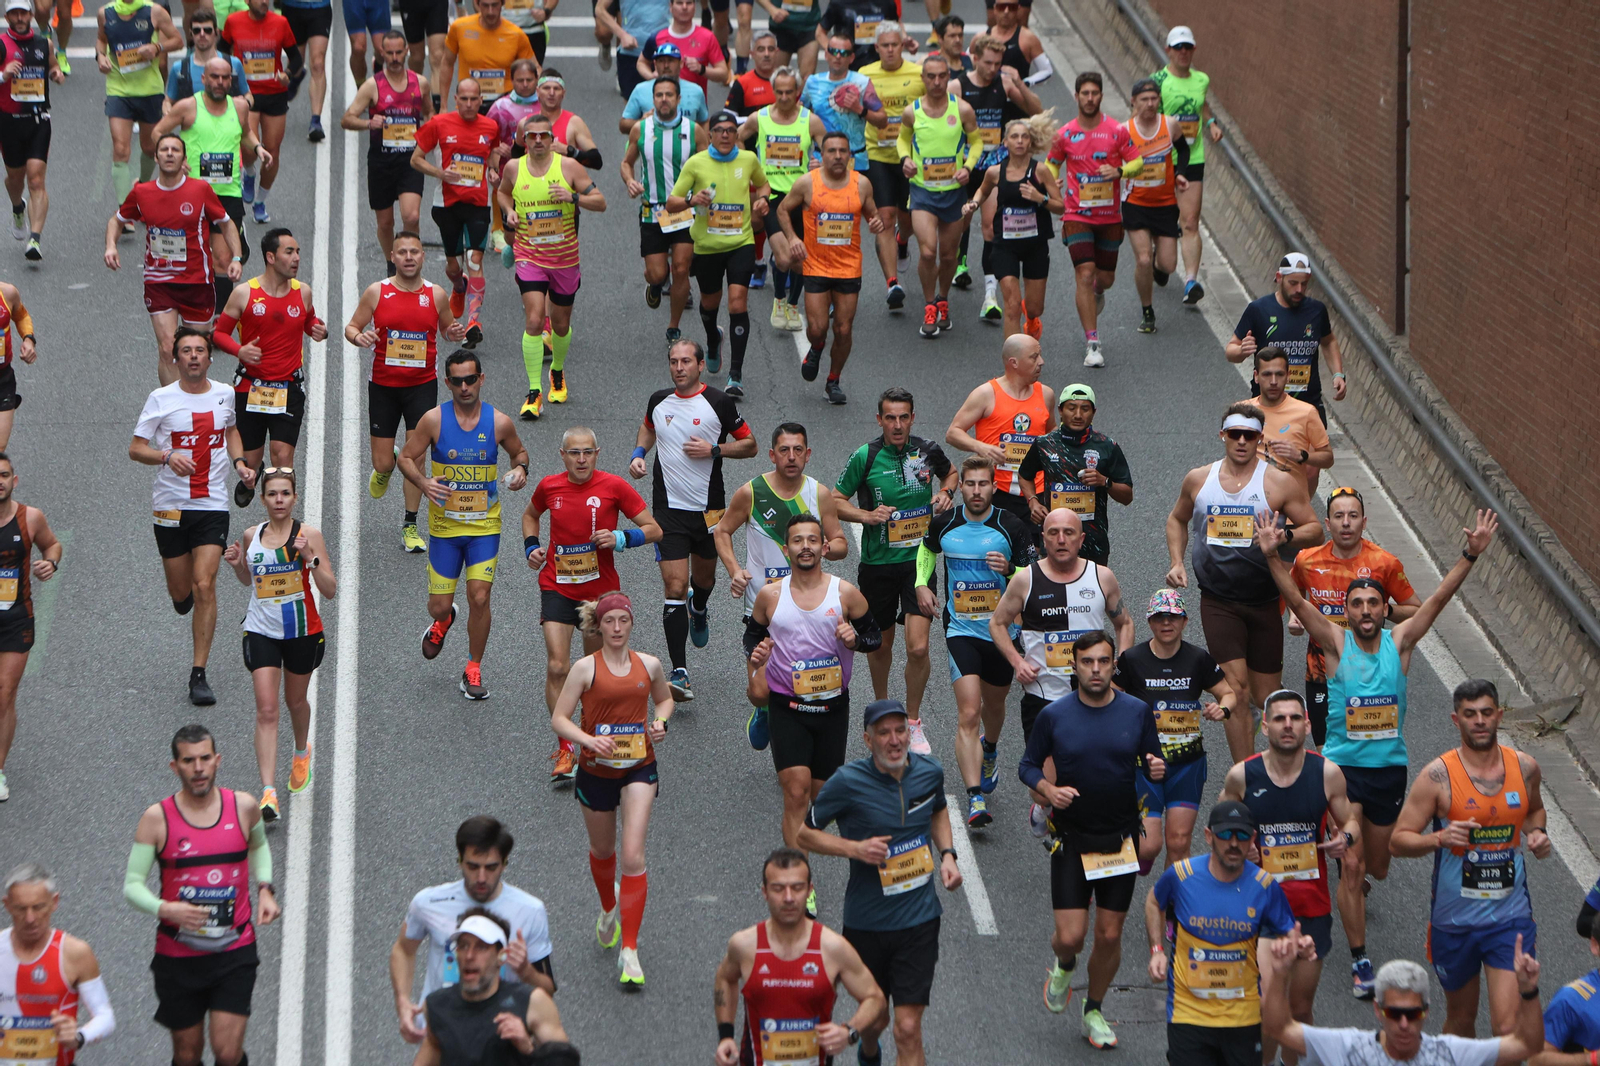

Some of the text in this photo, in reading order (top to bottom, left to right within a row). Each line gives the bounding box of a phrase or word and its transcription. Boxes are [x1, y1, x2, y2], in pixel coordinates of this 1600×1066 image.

[461, 155, 483, 164] ZURICH
[537, 211, 560, 219] ZURICH
[401, 332, 425, 340] ZURICH
[399, 343, 414, 351] 4282
[1012, 448, 1027, 456] 5370
[443, 465, 491, 483] OSSET
[459, 482, 484, 490] ZURICH
[1065, 484, 1092, 492] ZURICH
[1064, 496, 1080, 504] 5985
[903, 508, 927, 518] ZURICH
[1222, 506, 1249, 515] ZURICH
[903, 522, 919, 531] 4173
[1221, 520, 1238, 528] 5704
[901, 531, 923, 540] ERNESTO
[565, 544, 592, 554] ZURICH
[566, 558, 583, 567] 3694
[268, 563, 295, 573] ZURICH
[270, 577, 286, 587] 4798
[968, 581, 996, 590] ZURICH
[968, 595, 986, 603] 4970
[972, 605, 990, 613] BARBA
[808, 658, 835, 668] ZURICH
[809, 673, 826, 682] 4897
[1145, 677, 1191, 687] TRIBOOST
[811, 684, 828, 692] TICAS
[1363, 697, 1393, 706] ZURICH
[1169, 702, 1198, 711] ZURICH
[1363, 711, 1381, 720] 3757
[1259, 822, 1317, 834] FUENTERREBOLLO
[1278, 834, 1310, 844] ZURICH
[893, 838, 922, 855] ZURICH
[1280, 850, 1300, 860] 4753
[1482, 851, 1511, 861] ZURICH
[1102, 858, 1126, 867] SANTOS
[1282, 862, 1299, 871] DANI
[198, 887, 233, 898] ZURICH
[1189, 915, 1252, 932] agustinos
[1208, 951, 1241, 962] ZURICH
[1207, 967, 1228, 977] 4080
[1208, 981, 1226, 989] JUAN
[17, 1018, 52, 1029] ZURICH
[780, 1020, 814, 1030] ZURICH
